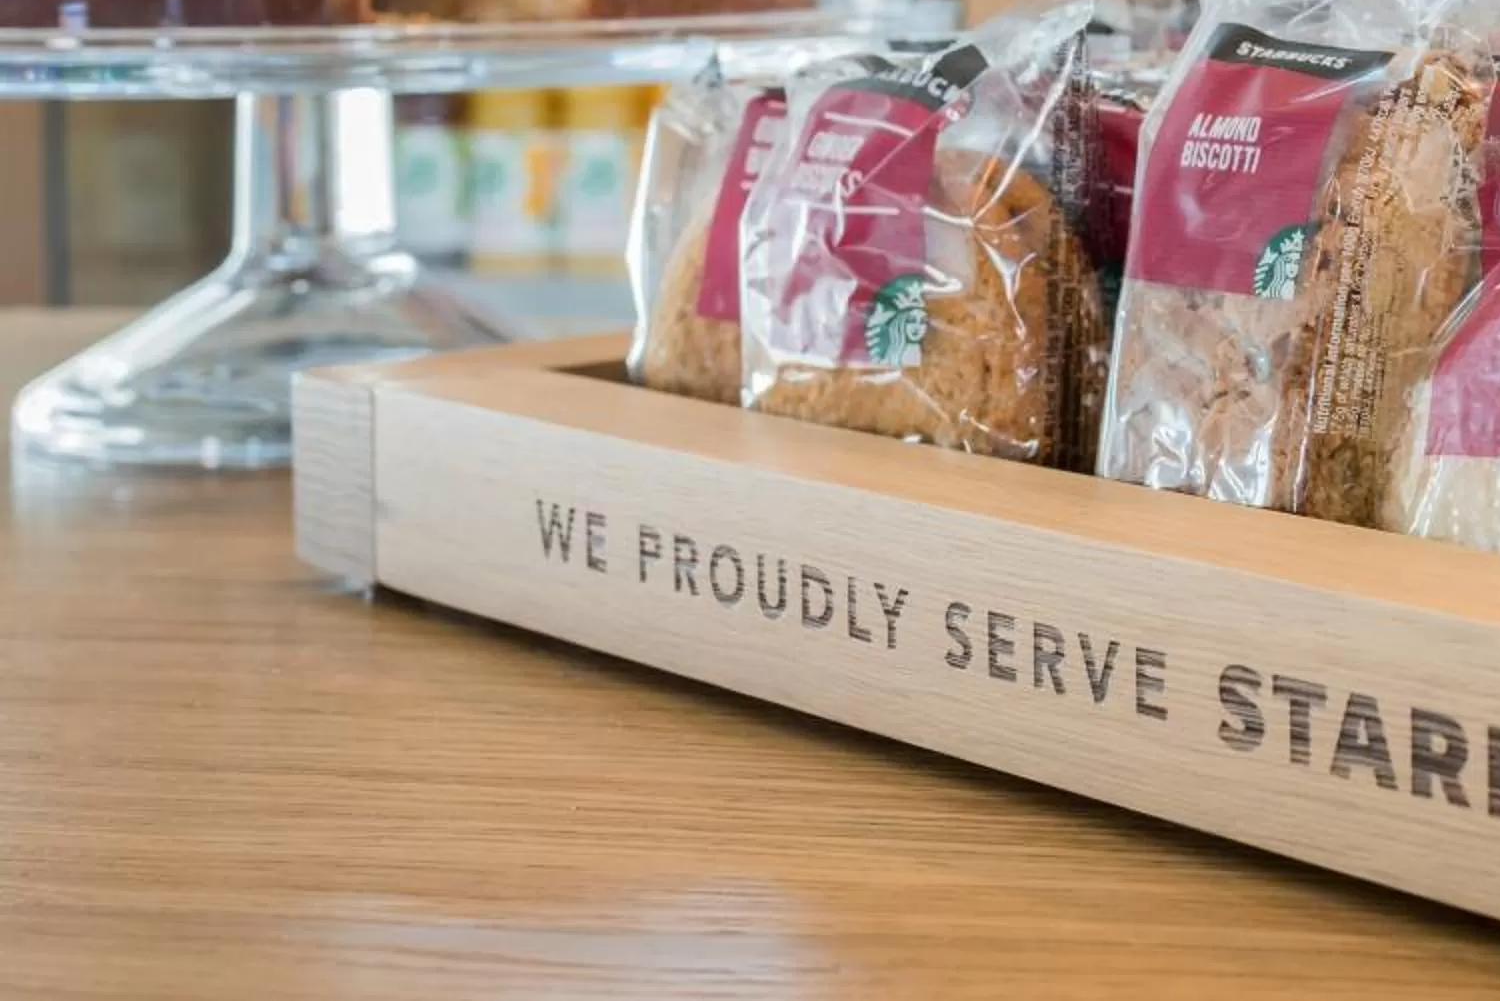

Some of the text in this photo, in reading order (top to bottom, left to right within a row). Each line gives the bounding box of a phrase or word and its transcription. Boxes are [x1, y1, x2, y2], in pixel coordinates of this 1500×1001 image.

[1236, 40, 1350, 70] STARBUCKS
[1188, 112, 1262, 144] ALMOND
[1180, 139, 1262, 174] BISCOTTI
[536, 499, 608, 573] WE
[638, 524, 909, 650] PROUDLY
[944, 602, 1169, 721] SERVE
